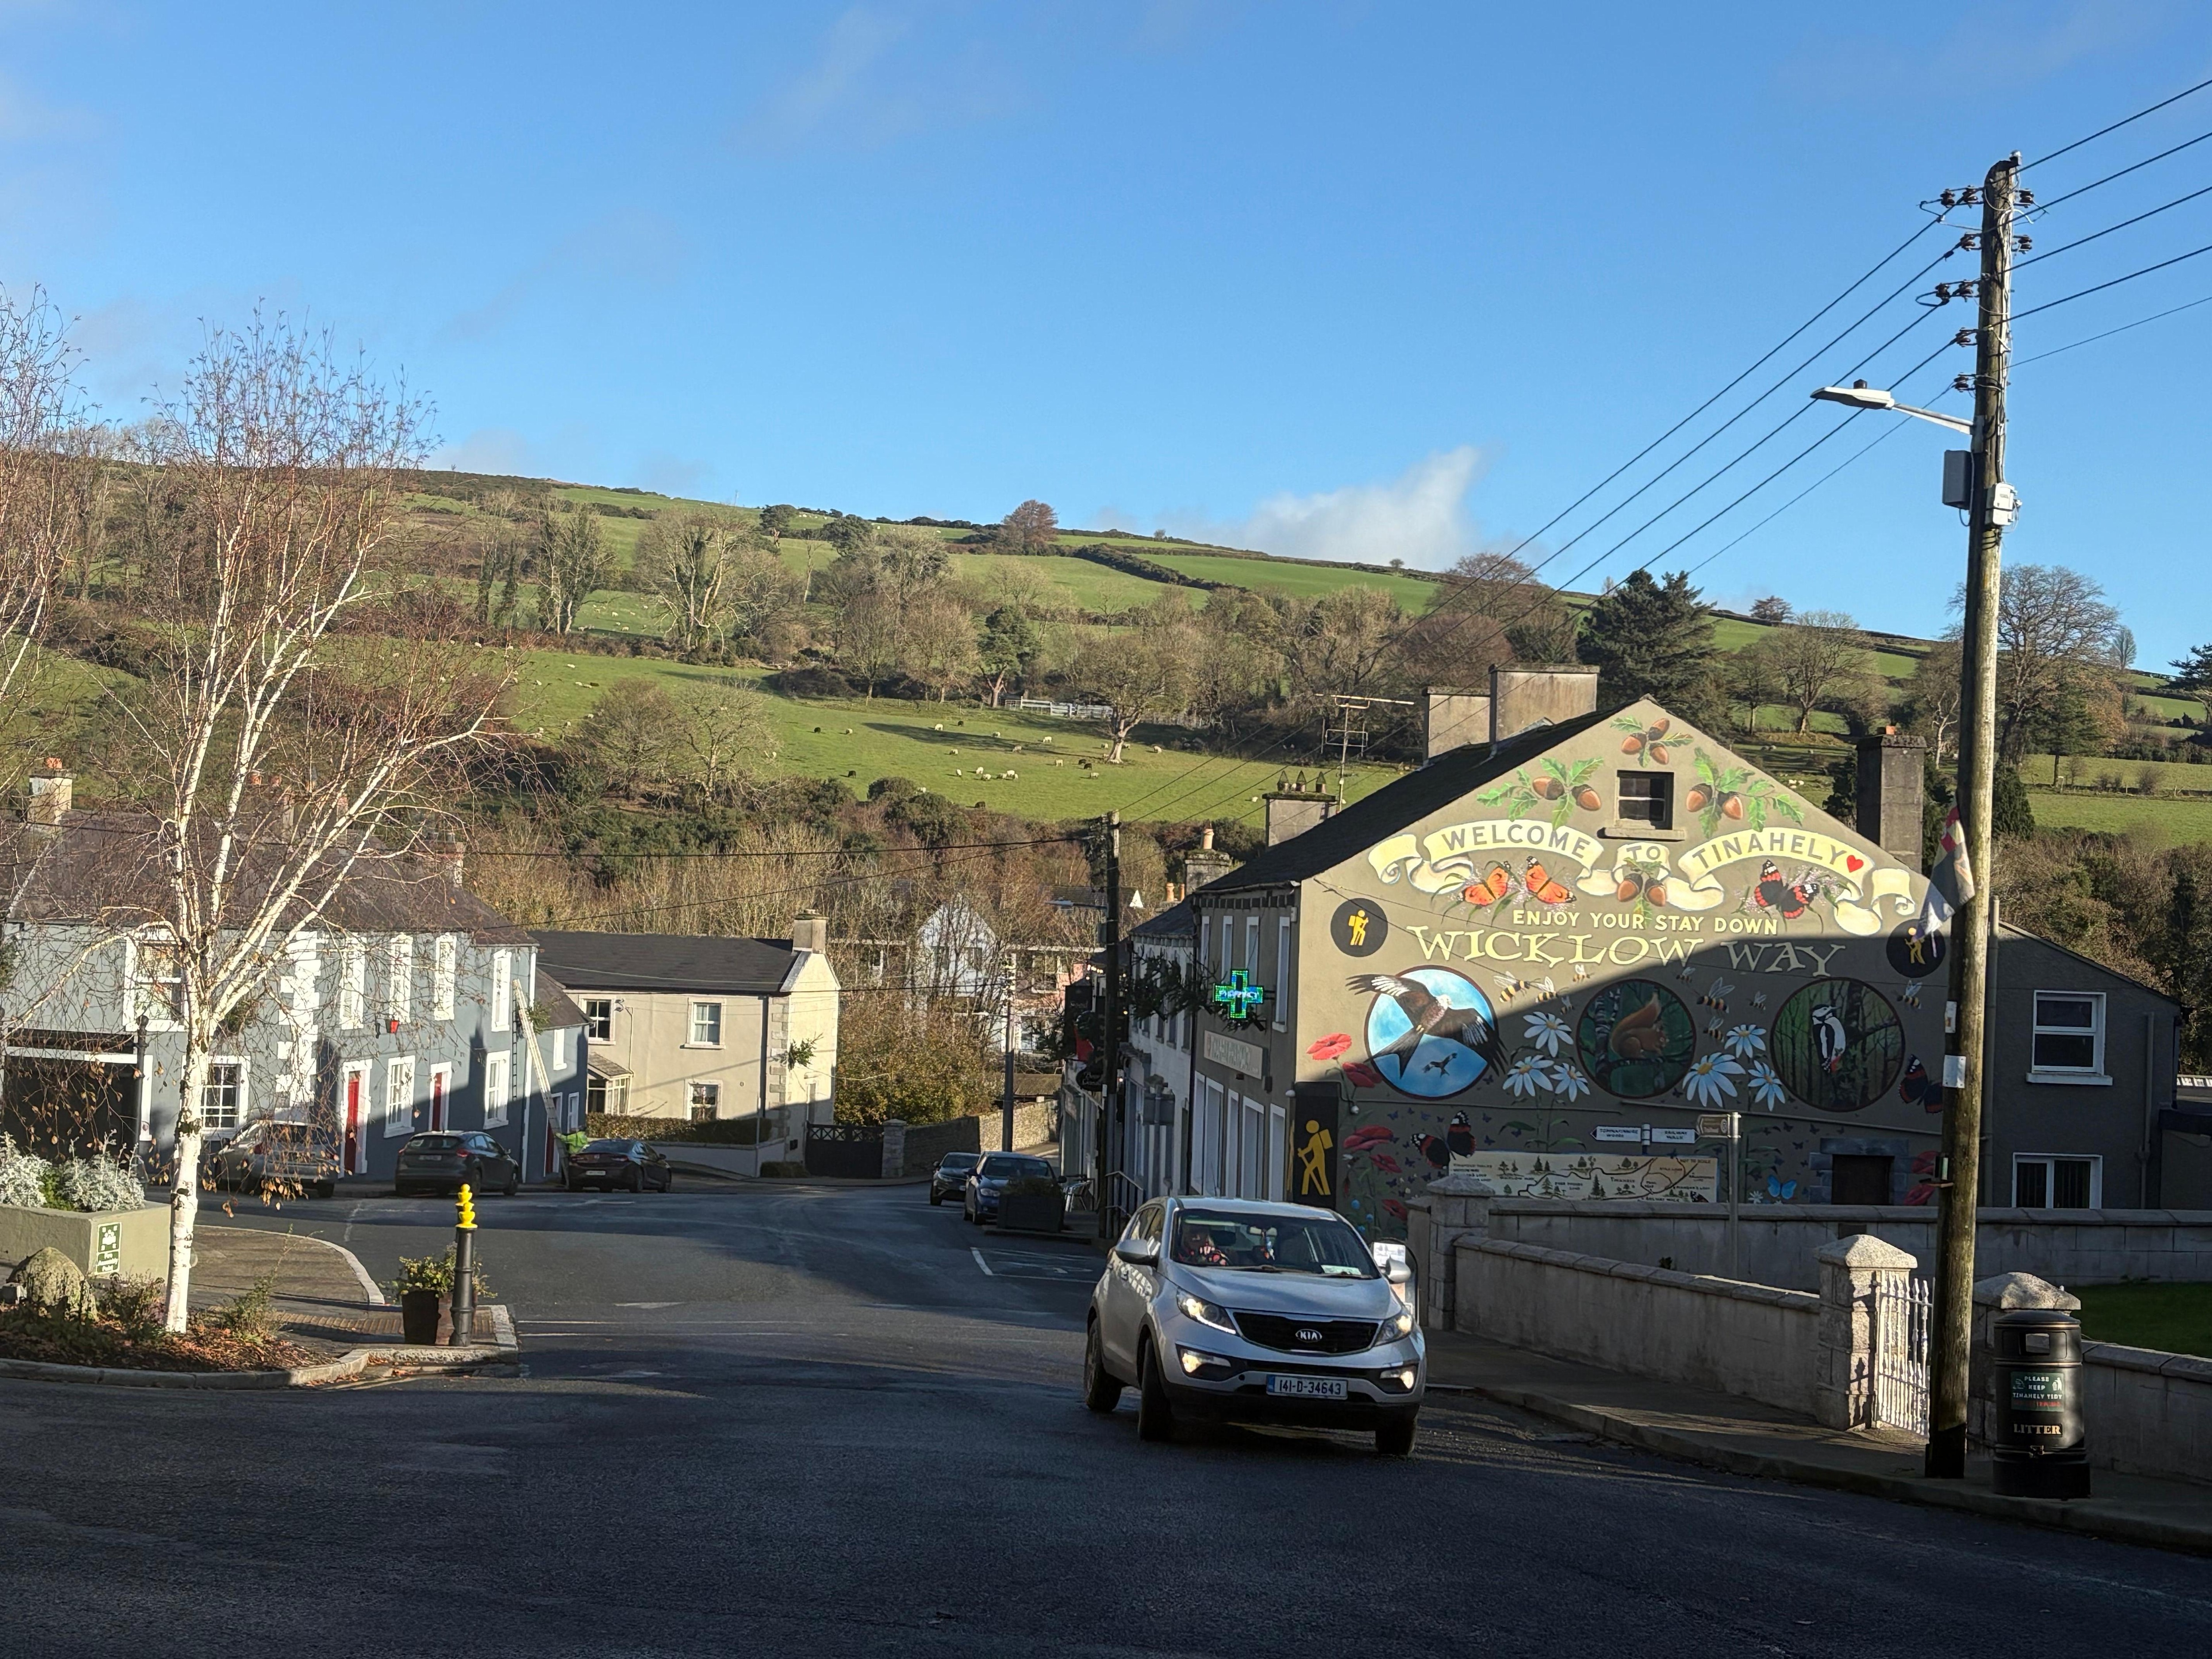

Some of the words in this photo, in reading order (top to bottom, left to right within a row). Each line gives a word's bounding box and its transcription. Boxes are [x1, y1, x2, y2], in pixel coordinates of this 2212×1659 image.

[1442, 824, 1591, 859] WELCOME
[1626, 845, 1660, 861] TO
[1692, 832, 1847, 869] TINAHELY
[1513, 910, 1580, 927] ENJOY
[1590, 912, 1645, 929] YOUR
[1655, 914, 1704, 932] STAY
[1714, 917, 1778, 935] DOWN
[1406, 925, 1704, 968] WICKLOW
[1720, 941, 1846, 977] WAY
[1300, 1331, 1318, 1340] KIA
[1279, 1379, 1341, 1395] 141-D-34643
[2014, 1423, 2062, 1434] LITTER
